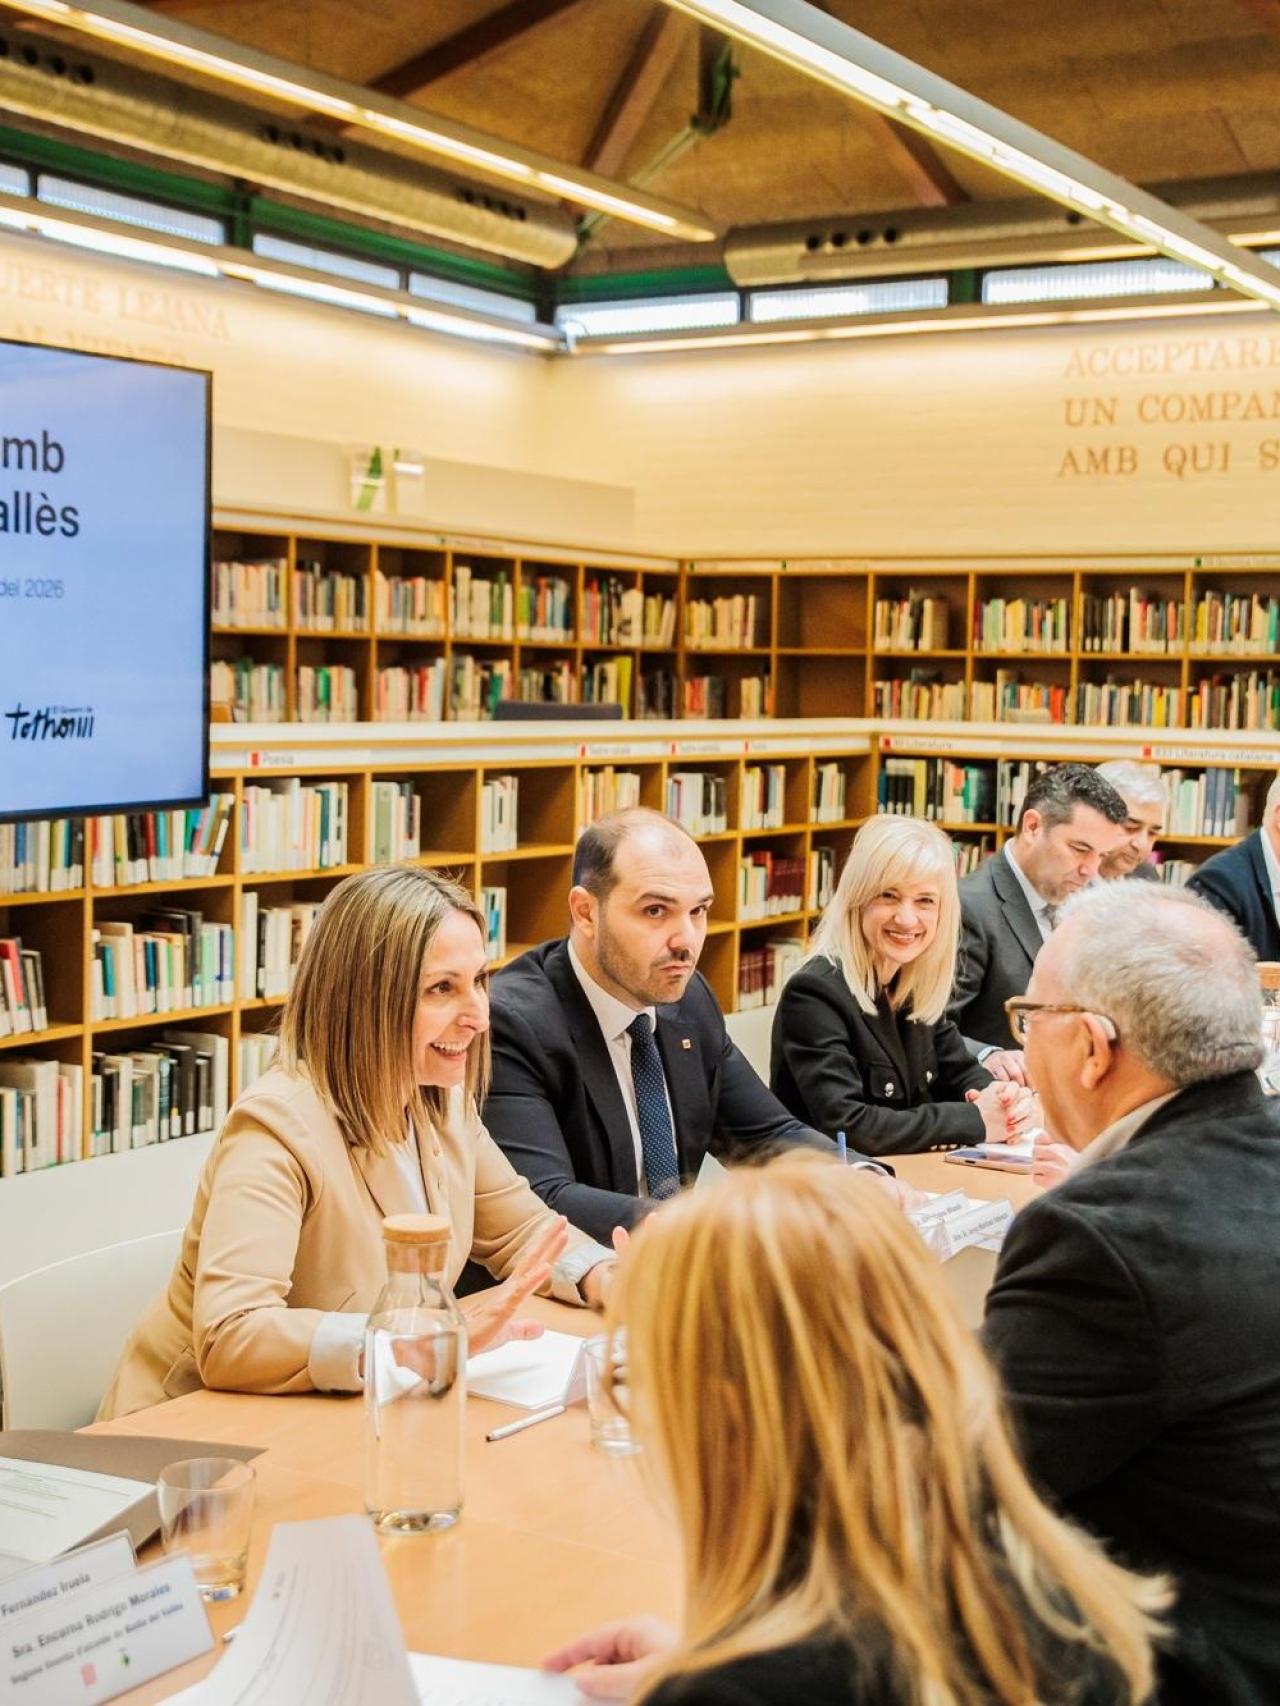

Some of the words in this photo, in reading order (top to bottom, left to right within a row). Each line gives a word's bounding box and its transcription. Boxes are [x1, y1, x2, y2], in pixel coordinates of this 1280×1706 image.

[1064, 396, 1119, 428] UN
[1057, 445, 1138, 478] AMB
[1163, 442, 1230, 480] QUI
[25, 578, 65, 599] 2026
